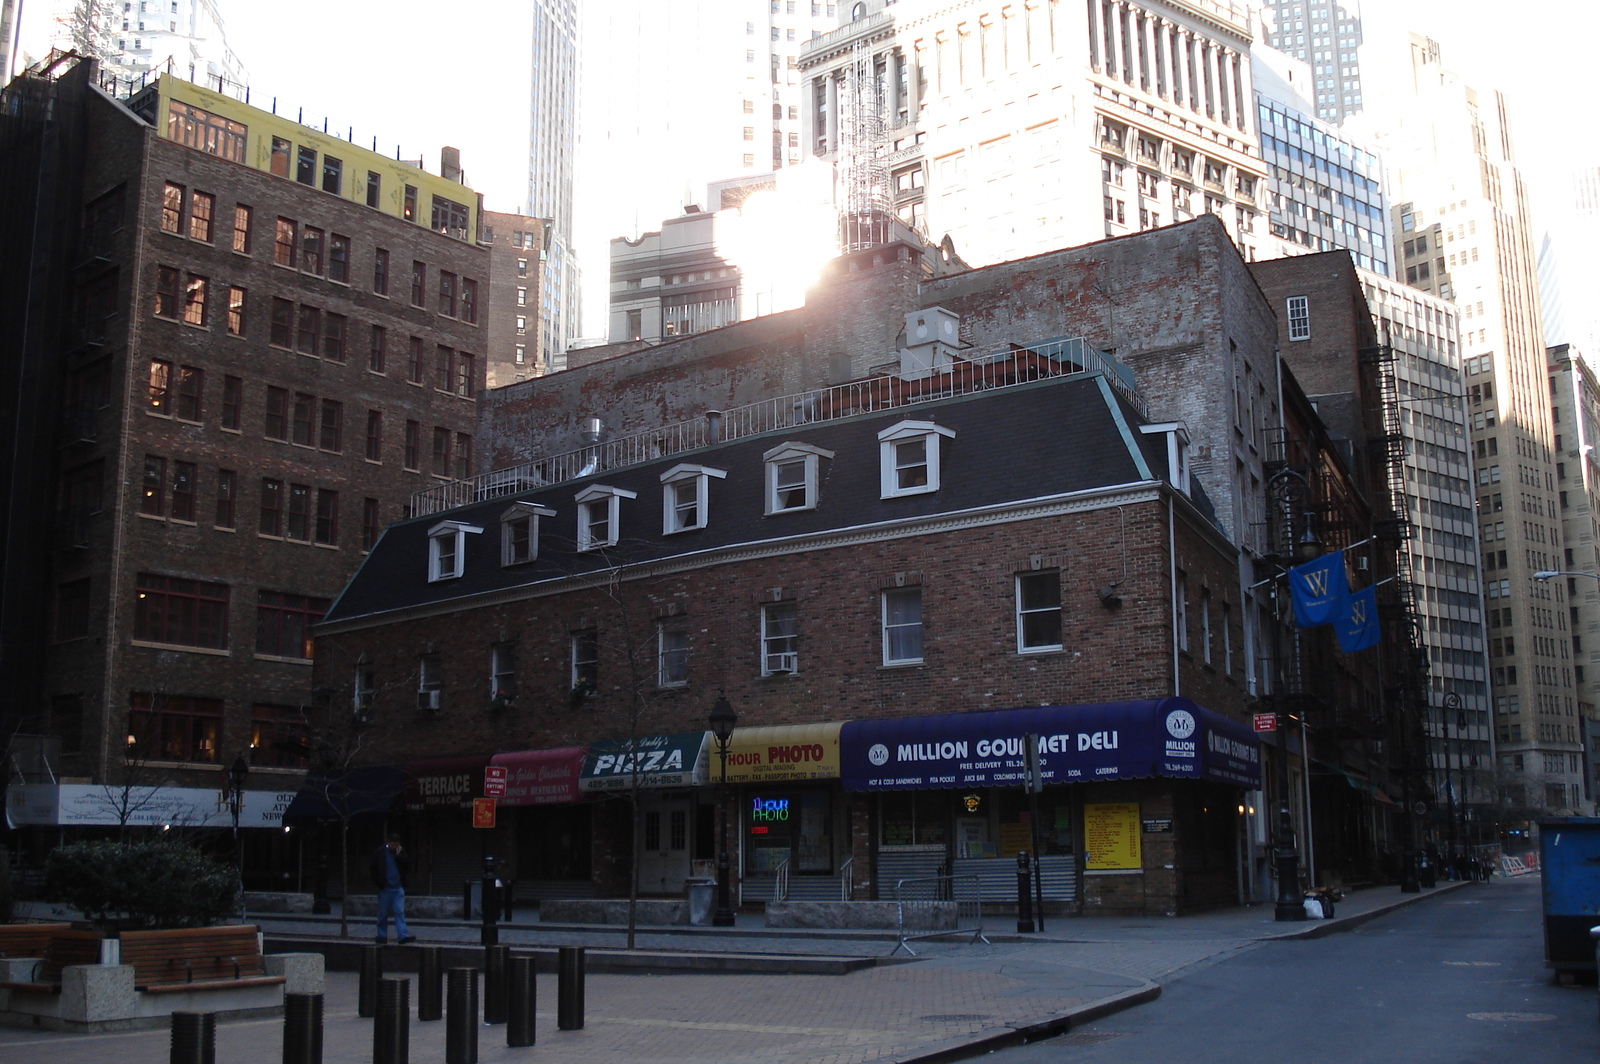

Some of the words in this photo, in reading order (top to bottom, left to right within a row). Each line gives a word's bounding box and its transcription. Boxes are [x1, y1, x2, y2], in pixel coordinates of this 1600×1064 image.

[1303, 568, 1330, 598] W
[897, 740, 969, 762] MILLION
[976, 733, 1070, 758] GOUMET
[1077, 730, 1119, 752] DELI
[1165, 740, 1196, 751] MILLION
[728, 752, 761, 766] HOUR
[768, 743, 824, 764] PHOTO
[593, 748, 683, 775] PIZZA
[960, 762, 974, 770] FREE
[975, 760, 1002, 769] DELIVERY
[753, 764, 773, 773] DIGITAL
[773, 763, 796, 772] IMAGING
[1067, 769, 1081, 777] SODA
[1095, 766, 1118, 776] CATERING
[727, 774, 749, 782] BATTERY
[752, 773, 761, 781] FAX
[765, 772, 789, 780] PASSPORT
[790, 771, 807, 779] PHOTO
[418, 774, 471, 795] TERRACE
[506, 787, 528, 796] HINESE
[531, 784, 570, 795] RESTAURANT
[426, 795, 440, 804] FISH
[762, 798, 789, 811] HOUR
[752, 809, 789, 822] PHOTO
